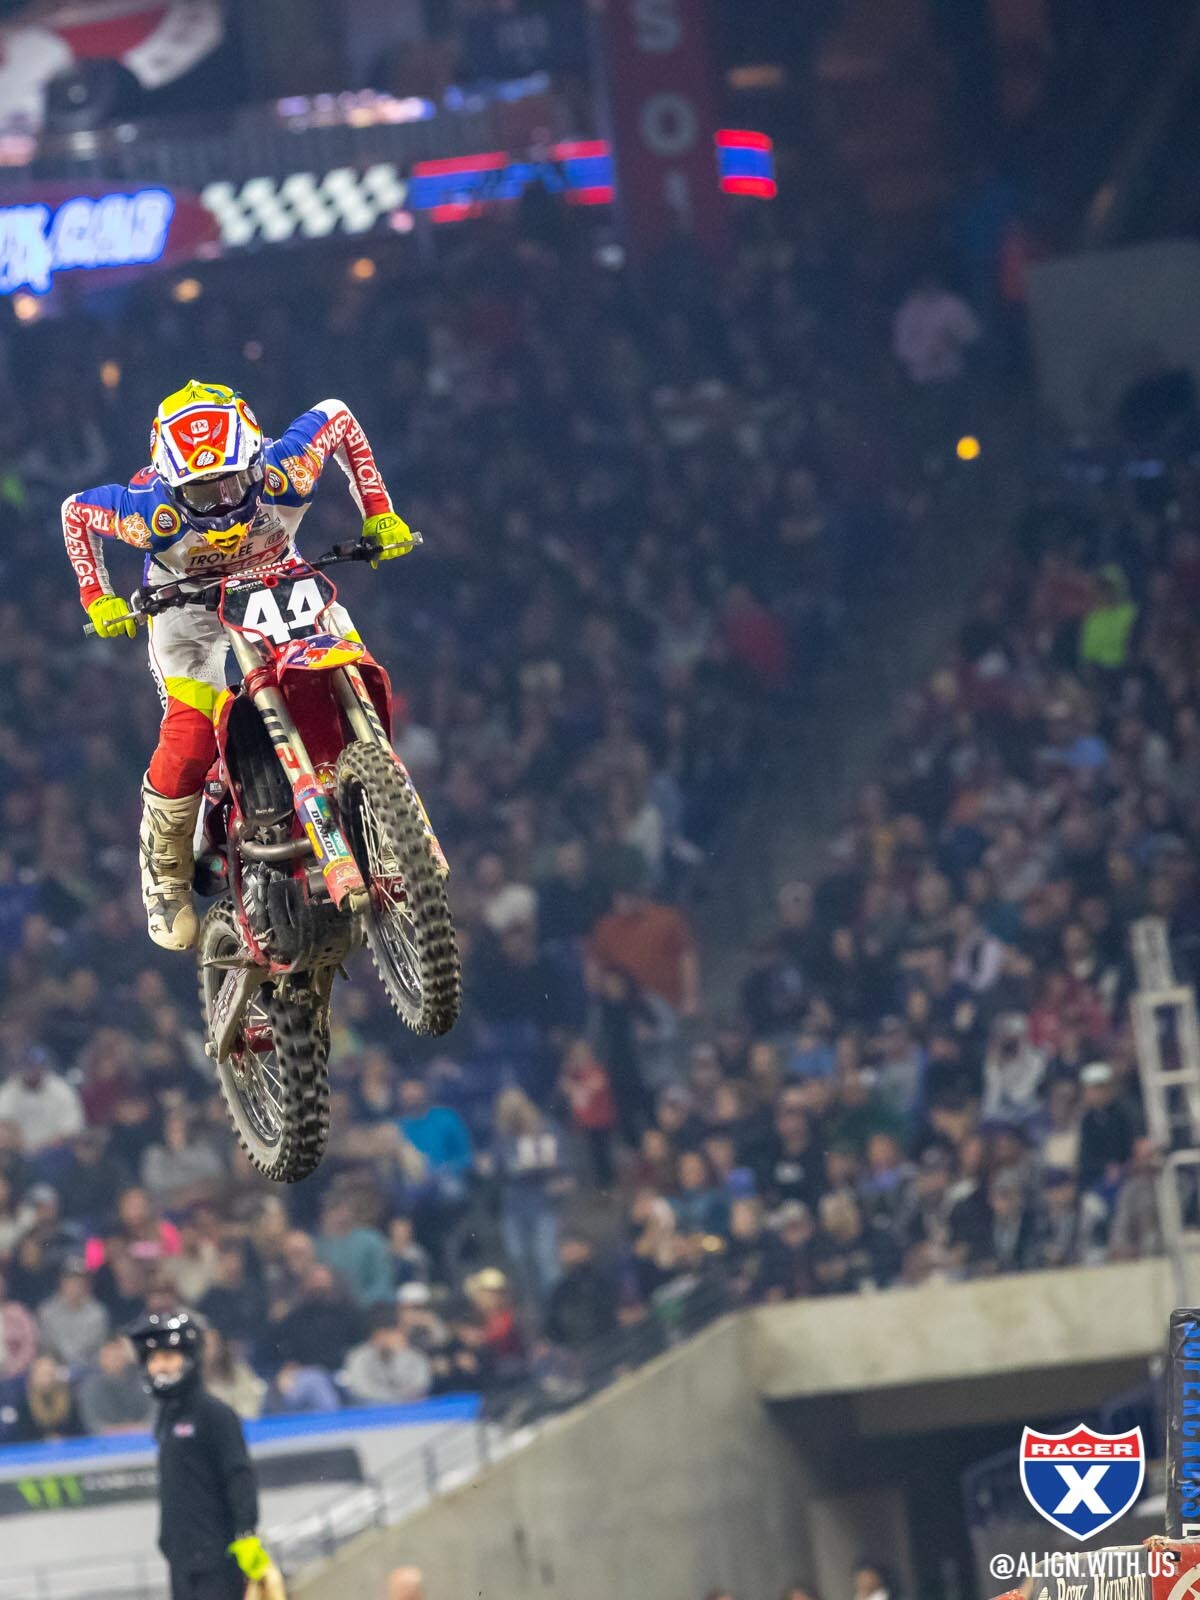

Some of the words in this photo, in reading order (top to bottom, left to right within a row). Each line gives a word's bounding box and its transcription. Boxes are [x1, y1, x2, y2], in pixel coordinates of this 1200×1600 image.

[191, 552, 228, 566] TROY
[231, 543, 254, 558] LEE
[241, 578, 327, 644] 44
